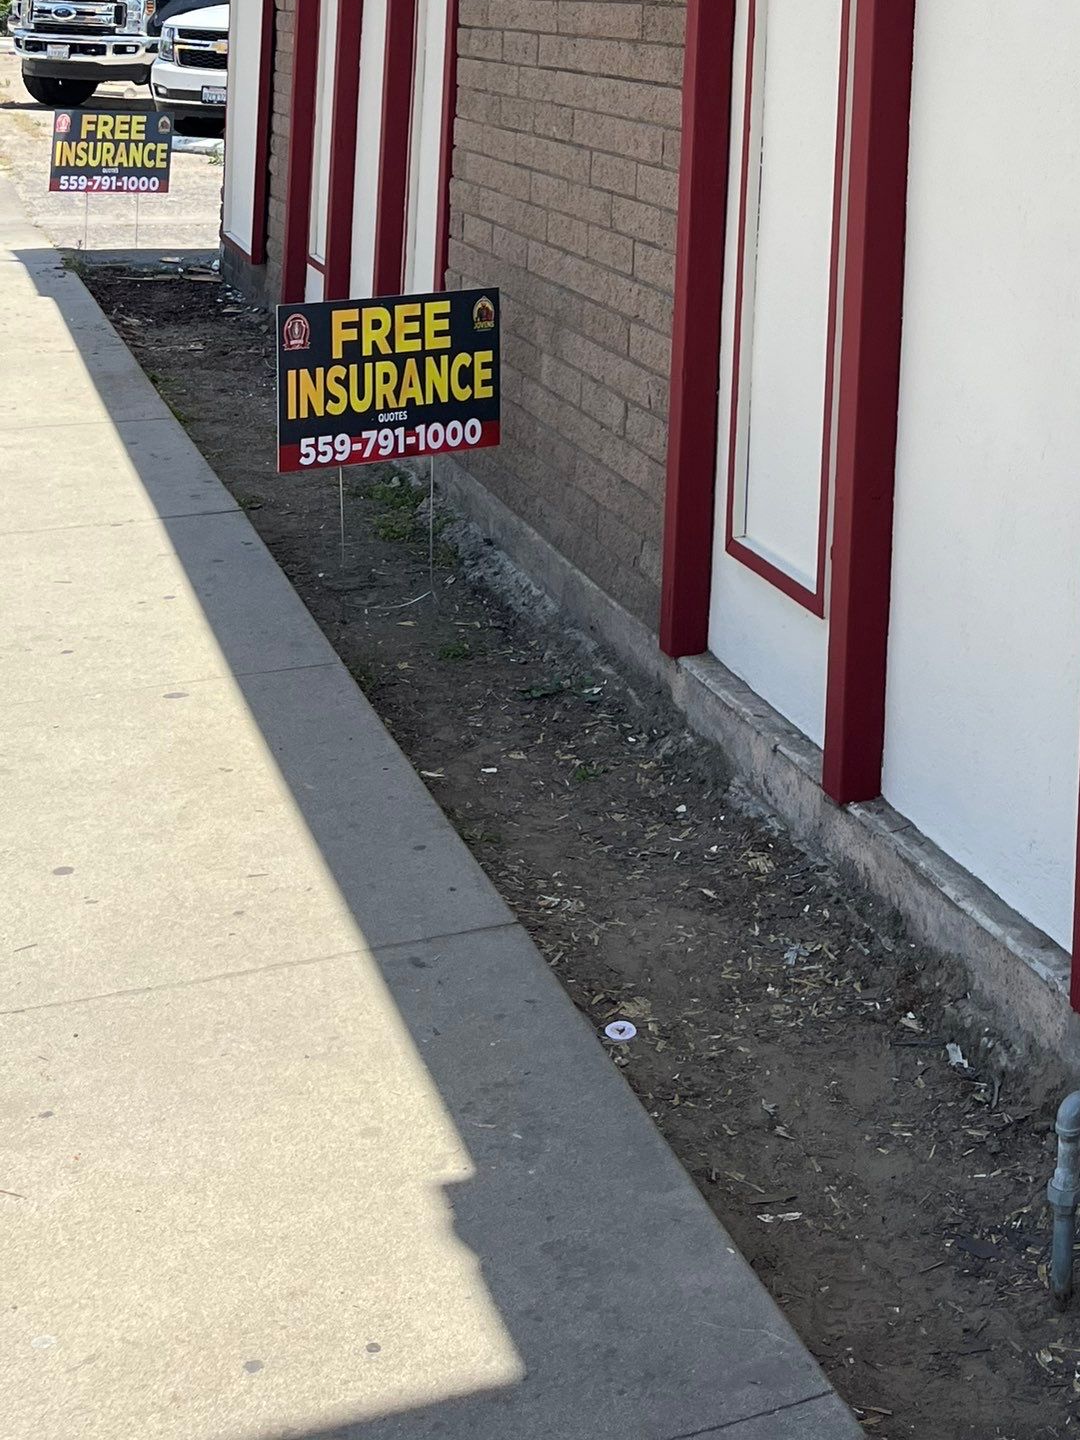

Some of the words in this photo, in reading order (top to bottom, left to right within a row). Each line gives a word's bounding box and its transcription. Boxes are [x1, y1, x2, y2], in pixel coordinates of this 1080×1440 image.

[81, 114, 147, 140] FREE
[55, 140, 169, 168] INSURANCE
[59, 175, 160, 191] 559-791-1000
[331, 300, 452, 359] FREE
[286, 350, 494, 420] INSURANCE
[378, 411, 408, 423] QUOTES
[299, 417, 483, 466] 559-791-1000
